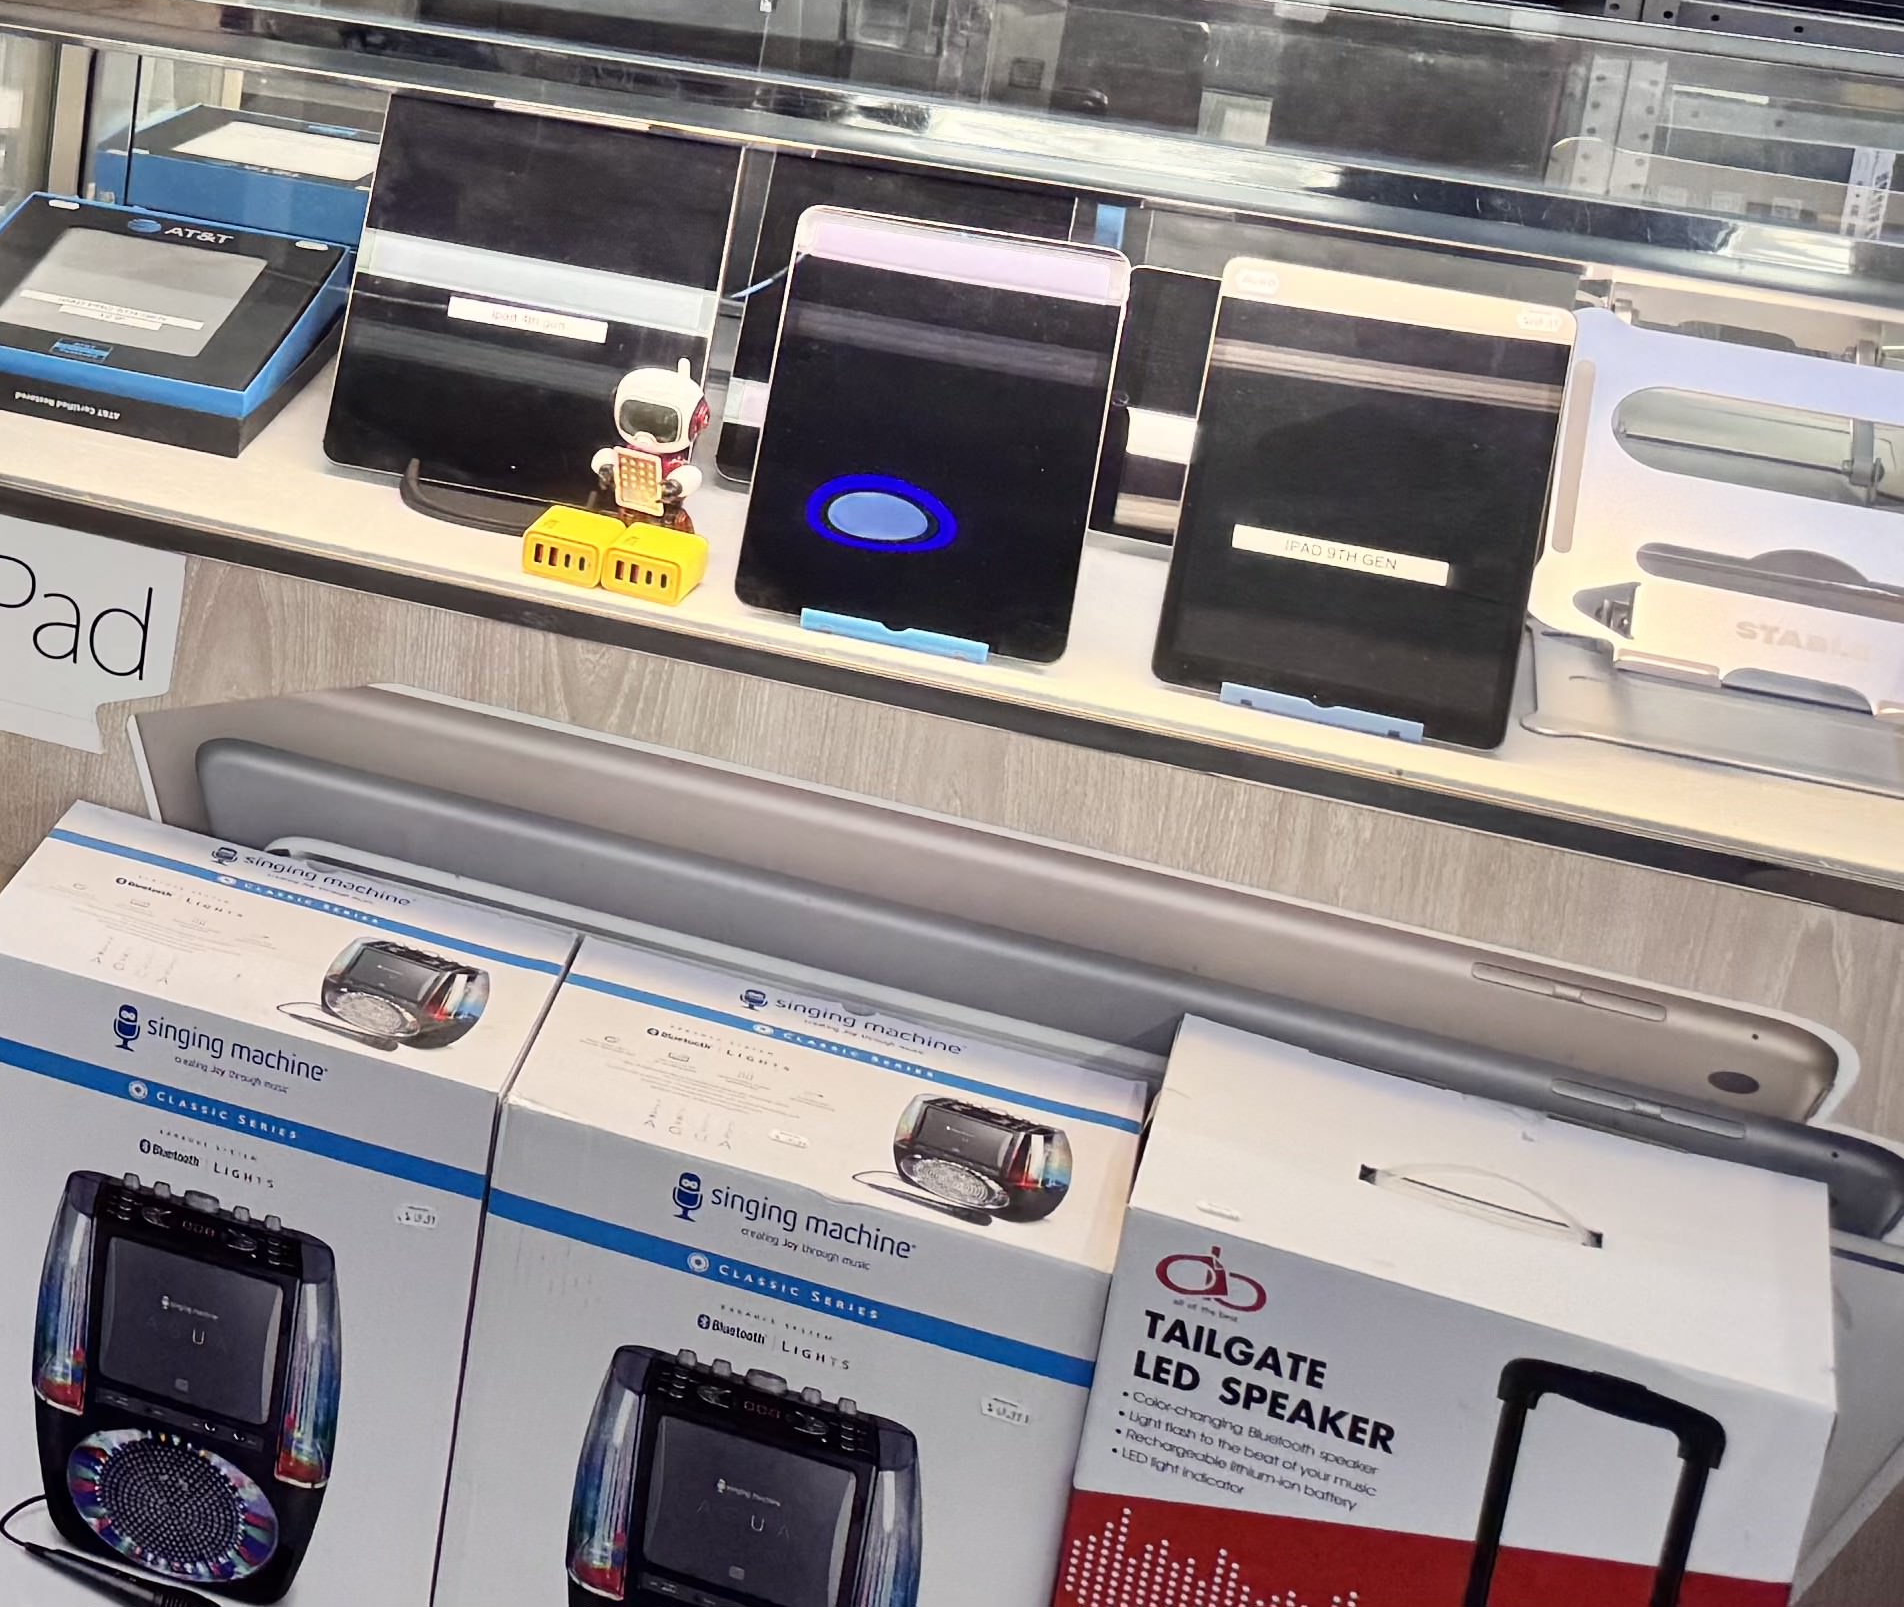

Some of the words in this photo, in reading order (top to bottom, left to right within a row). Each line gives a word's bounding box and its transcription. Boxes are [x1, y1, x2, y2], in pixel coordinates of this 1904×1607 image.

[164, 225, 235, 246] AT&T
[1285, 537, 1323, 558] IPAD
[1326, 545, 1358, 564] 9TH
[1361, 551, 1398, 572] GEN
[243, 850, 318, 886] singing
[321, 874, 414, 909] machine
[146, 1014, 224, 1058] singing
[230, 1042, 325, 1085] machine
[775, 996, 859, 1033] singing
[863, 1019, 965, 1055] machine
[155, 1088, 229, 1122] CLASSIC
[237, 1113, 298, 1140] SERIES
[152, 1142, 200, 1168] Bluetooth
[213, 1160, 275, 1190] LIGHTS
[711, 1185, 798, 1234] singing
[804, 1214, 913, 1261] machine
[718, 1263, 800, 1298] CLASSIC
[809, 1289, 880, 1321] SERIES
[711, 1317, 767, 1346] Bluetooth
[780, 1338, 852, 1372] LIGHTS
[1144, 1308, 1328, 1392] TAILGATE
[1132, 1350, 1201, 1392] LED
[1217, 1375, 1395, 1456] SPEAKER
[1129, 1410, 1162, 1431] Light
[1165, 1418, 1196, 1441] flash
[1199, 1430, 1213, 1444] to
[1217, 1432, 1242, 1453] the
[1244, 1446, 1280, 1468] beat
[1282, 1456, 1298, 1472] of
[1299, 1462, 1333, 1486] your
[1333, 1476, 1377, 1498] music
[1133, 1391, 1243, 1436] Color-changing
[1248, 1427, 1316, 1456] Bluetooth
[1319, 1450, 1379, 1479] speaker
[1122, 1446, 1149, 1465] LED
[1150, 1455, 1180, 1477] light
[1182, 1463, 1245, 1496] indicator
[1126, 1429, 1228, 1472] Rechargeable
[1230, 1459, 1301, 1493] lithium-ion
[1303, 1484, 1358, 1513] battery
